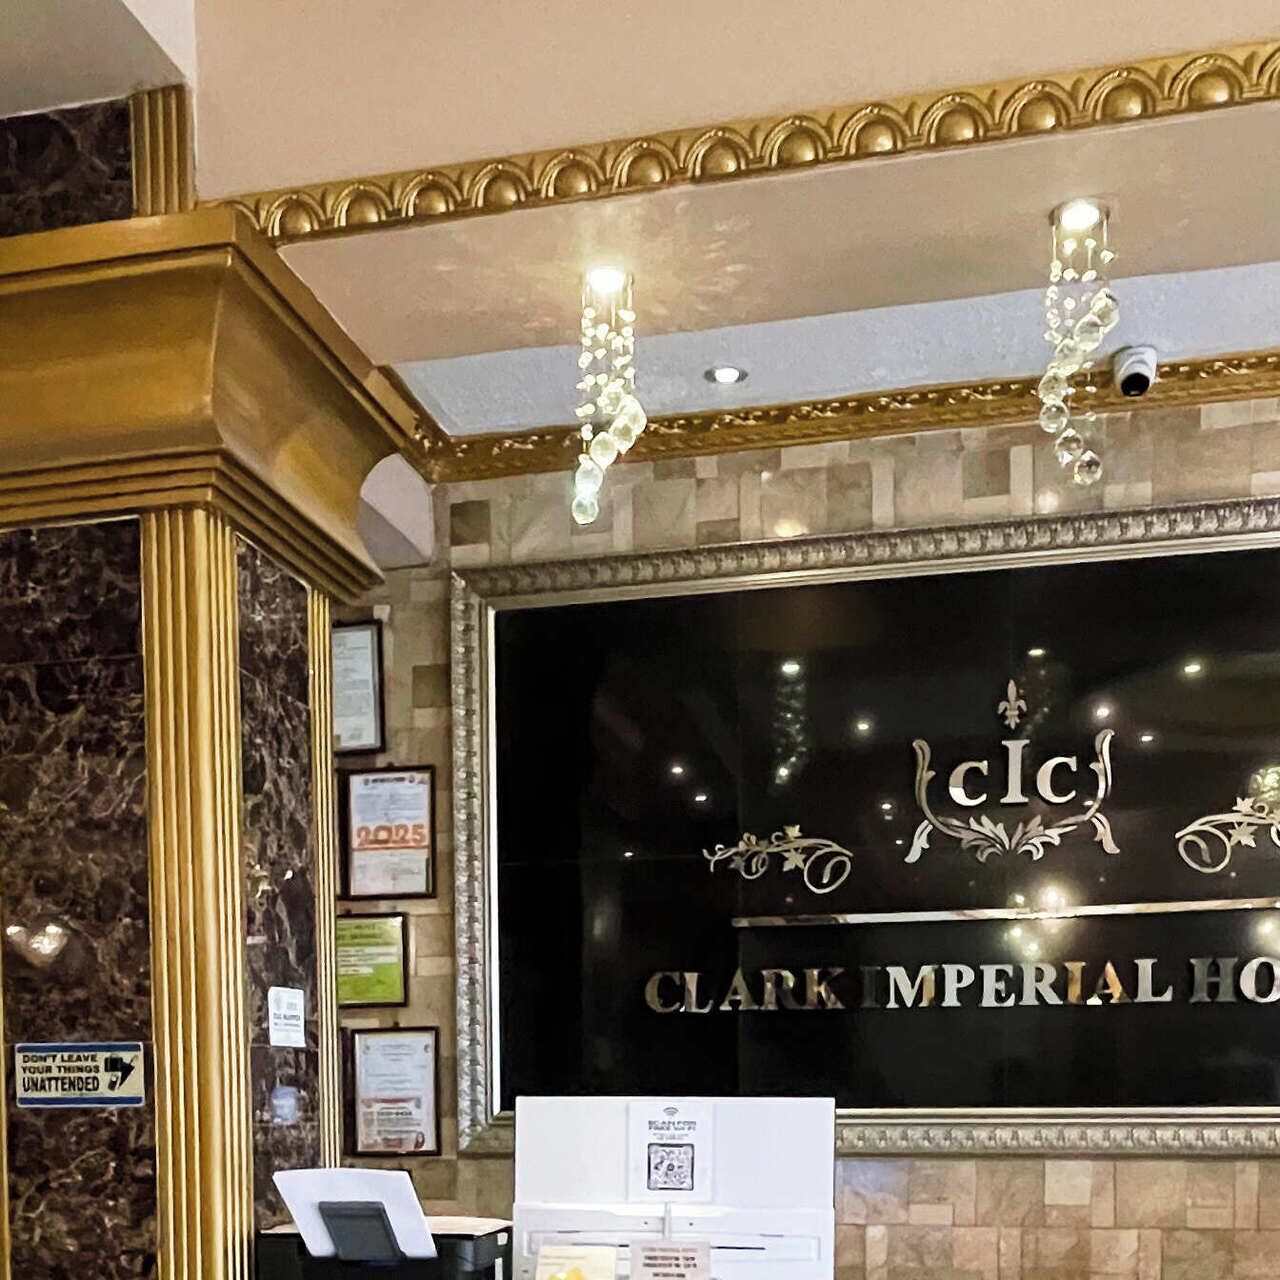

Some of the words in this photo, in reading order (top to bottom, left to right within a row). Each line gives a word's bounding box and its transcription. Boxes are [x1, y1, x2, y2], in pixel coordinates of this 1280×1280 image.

[356, 823, 427, 847] 2025
[645, 966, 846, 1014] CLARK
[860, 957, 1173, 1010] IMPERIAL
[22, 1054, 57, 1064] DON'T
[61, 1053, 97, 1063] LEAVE
[21, 1065, 52, 1074] YOUR
[56, 1065, 100, 1074] THINGS
[22, 1076, 100, 1092] UNATTENDED
